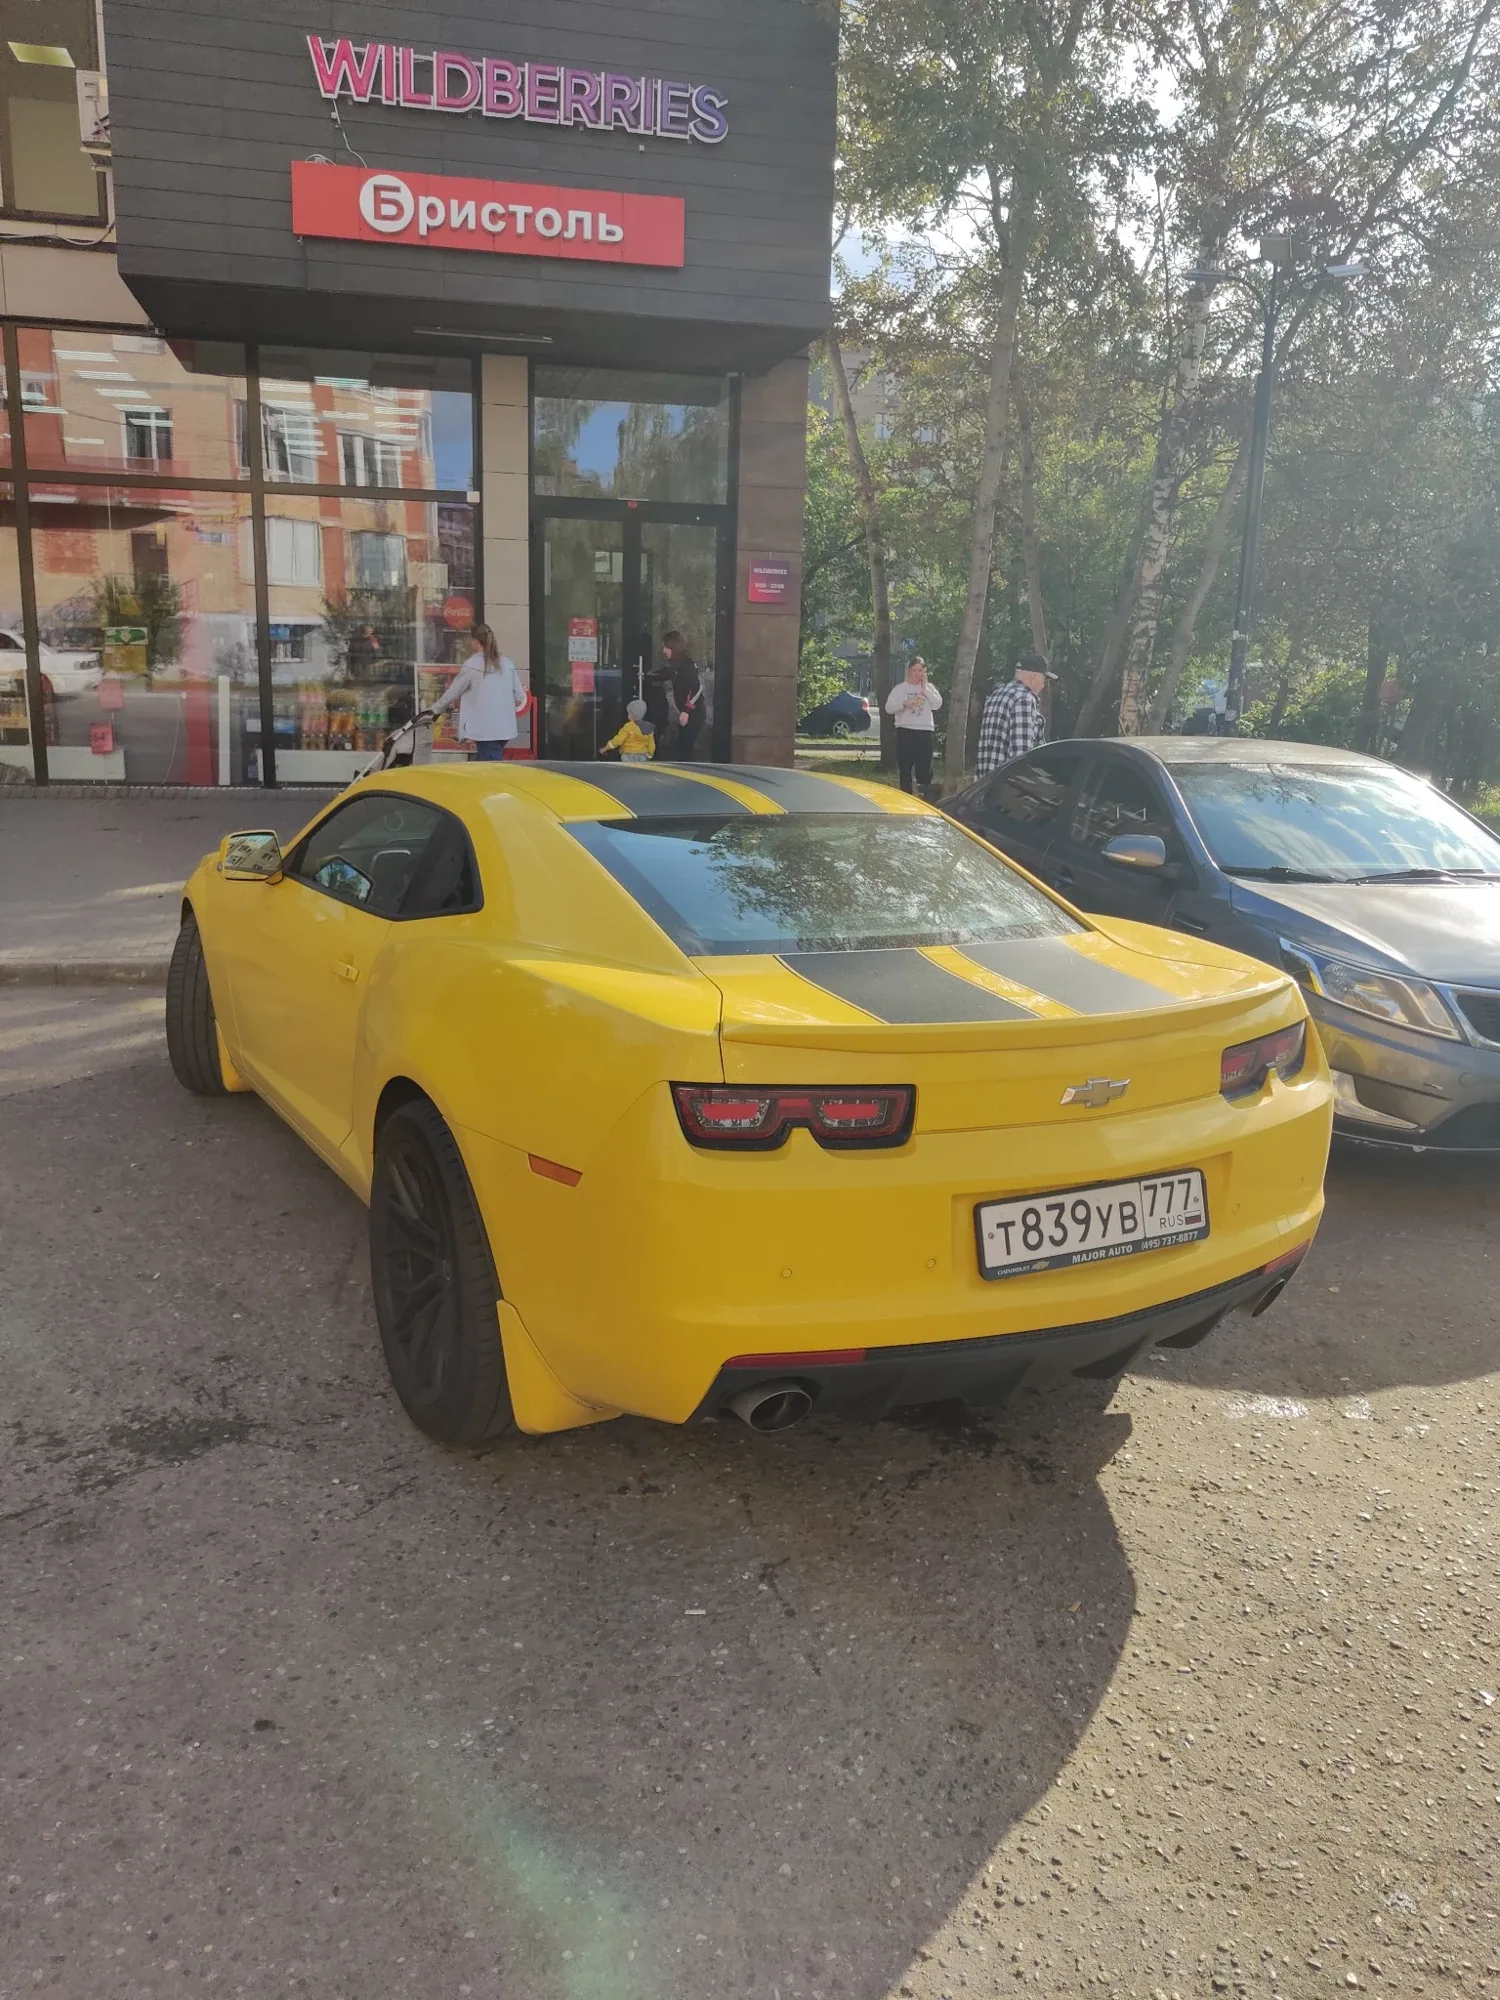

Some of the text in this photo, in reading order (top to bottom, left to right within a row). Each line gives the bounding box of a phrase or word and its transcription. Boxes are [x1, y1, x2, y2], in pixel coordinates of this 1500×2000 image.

[305, 34, 730, 144] WILDBERRIES
[359, 174, 625, 243] Бристоль
[1143, 1178, 1192, 1218] 777
[1159, 1214, 1184, 1229] RUS
[1072, 1249, 1107, 1265] MAJOR
[1108, 1244, 1133, 1258] AUTO
[1141, 1238, 1161, 1251] (495)
[1161, 1230, 1199, 1247] 737-8877
